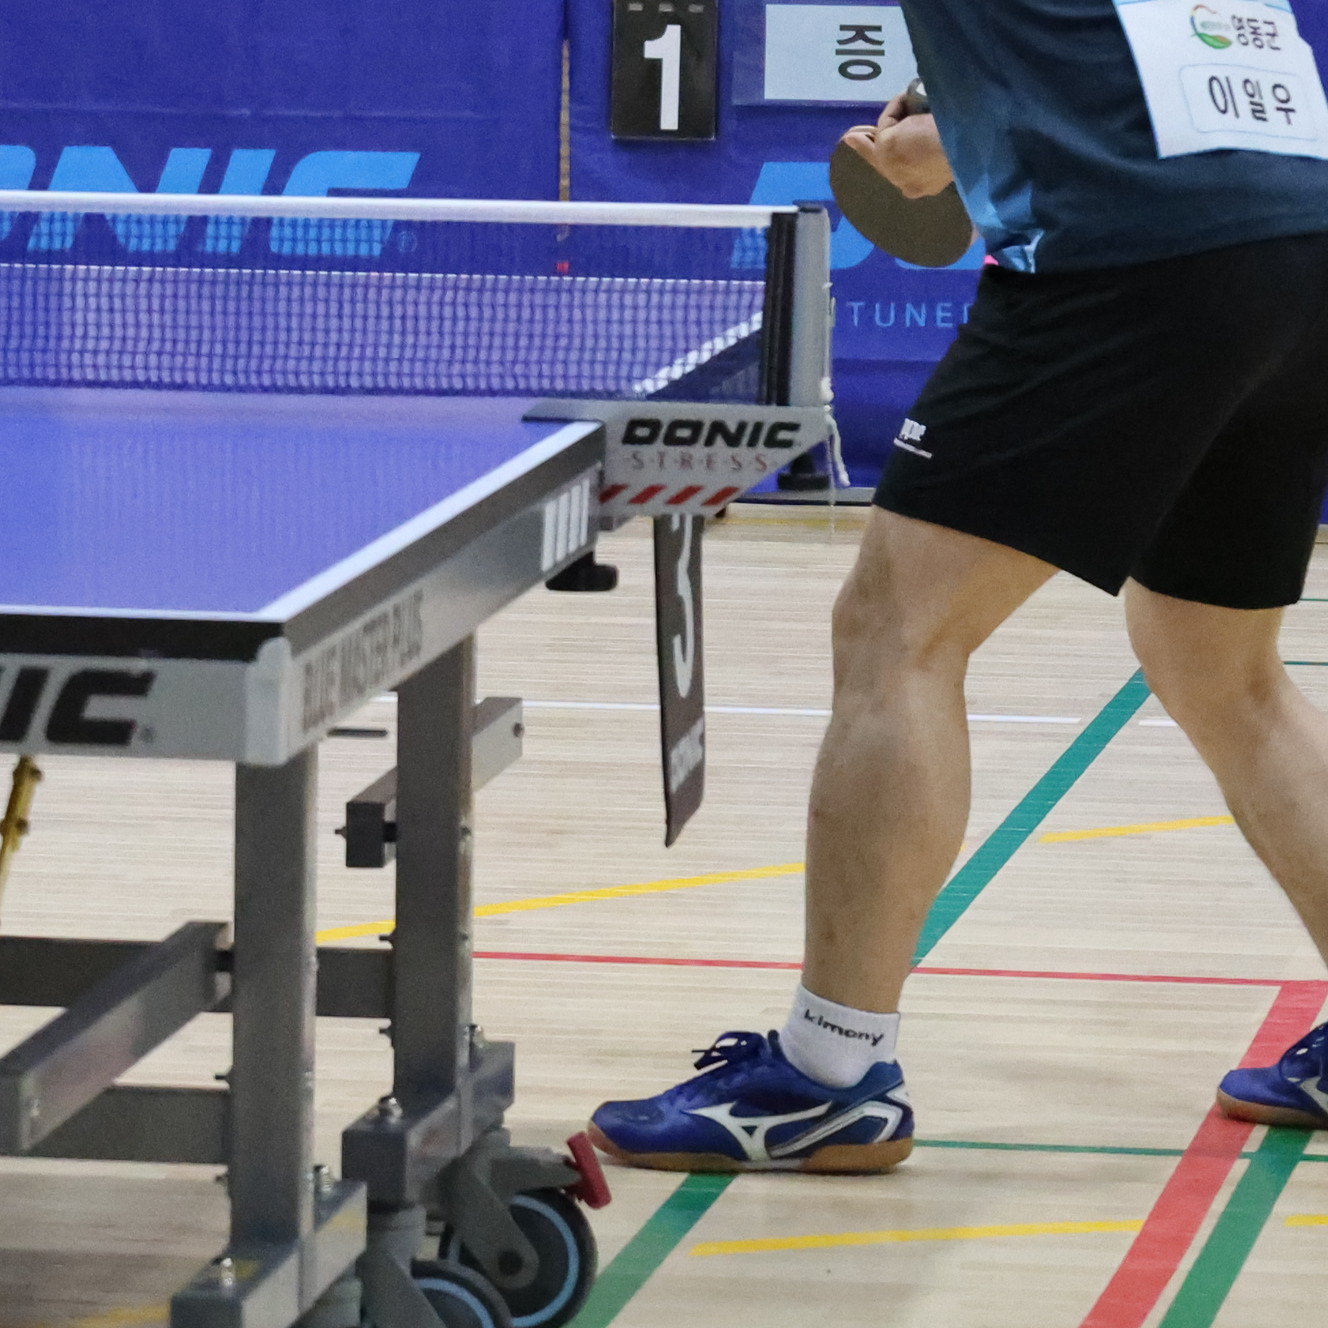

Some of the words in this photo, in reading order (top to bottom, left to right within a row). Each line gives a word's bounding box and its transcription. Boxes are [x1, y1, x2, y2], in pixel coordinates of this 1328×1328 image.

[1231, 13, 1281, 51] 영동군
[644, 24, 681, 130] 1
[1208, 75, 1296, 125] 이일우
[622, 418, 801, 449] DONIC
